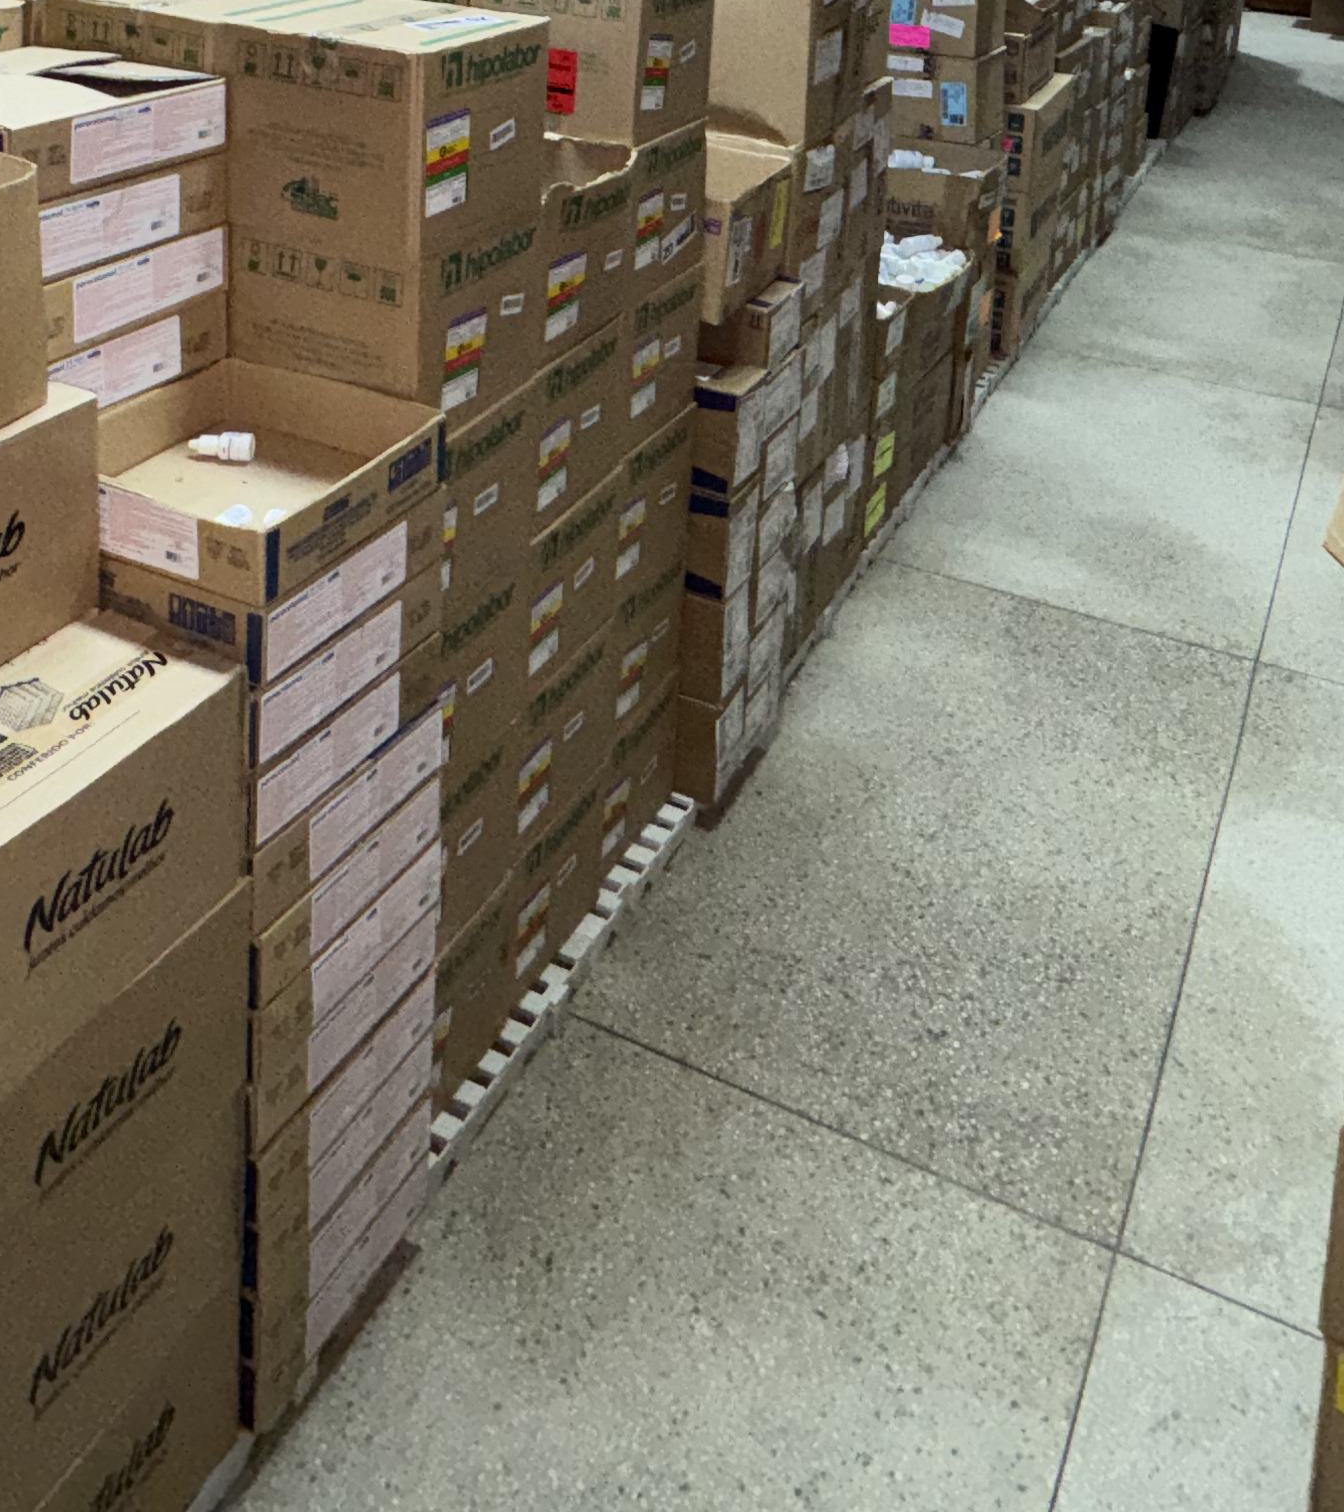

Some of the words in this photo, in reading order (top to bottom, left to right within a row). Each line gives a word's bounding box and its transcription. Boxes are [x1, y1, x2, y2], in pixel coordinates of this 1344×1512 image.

[68, 651, 168, 722] Natulab
[23, 798, 175, 955] Natulab
[34, 1016, 184, 1187] Natulab
[29, 1224, 175, 1406] Natulab
